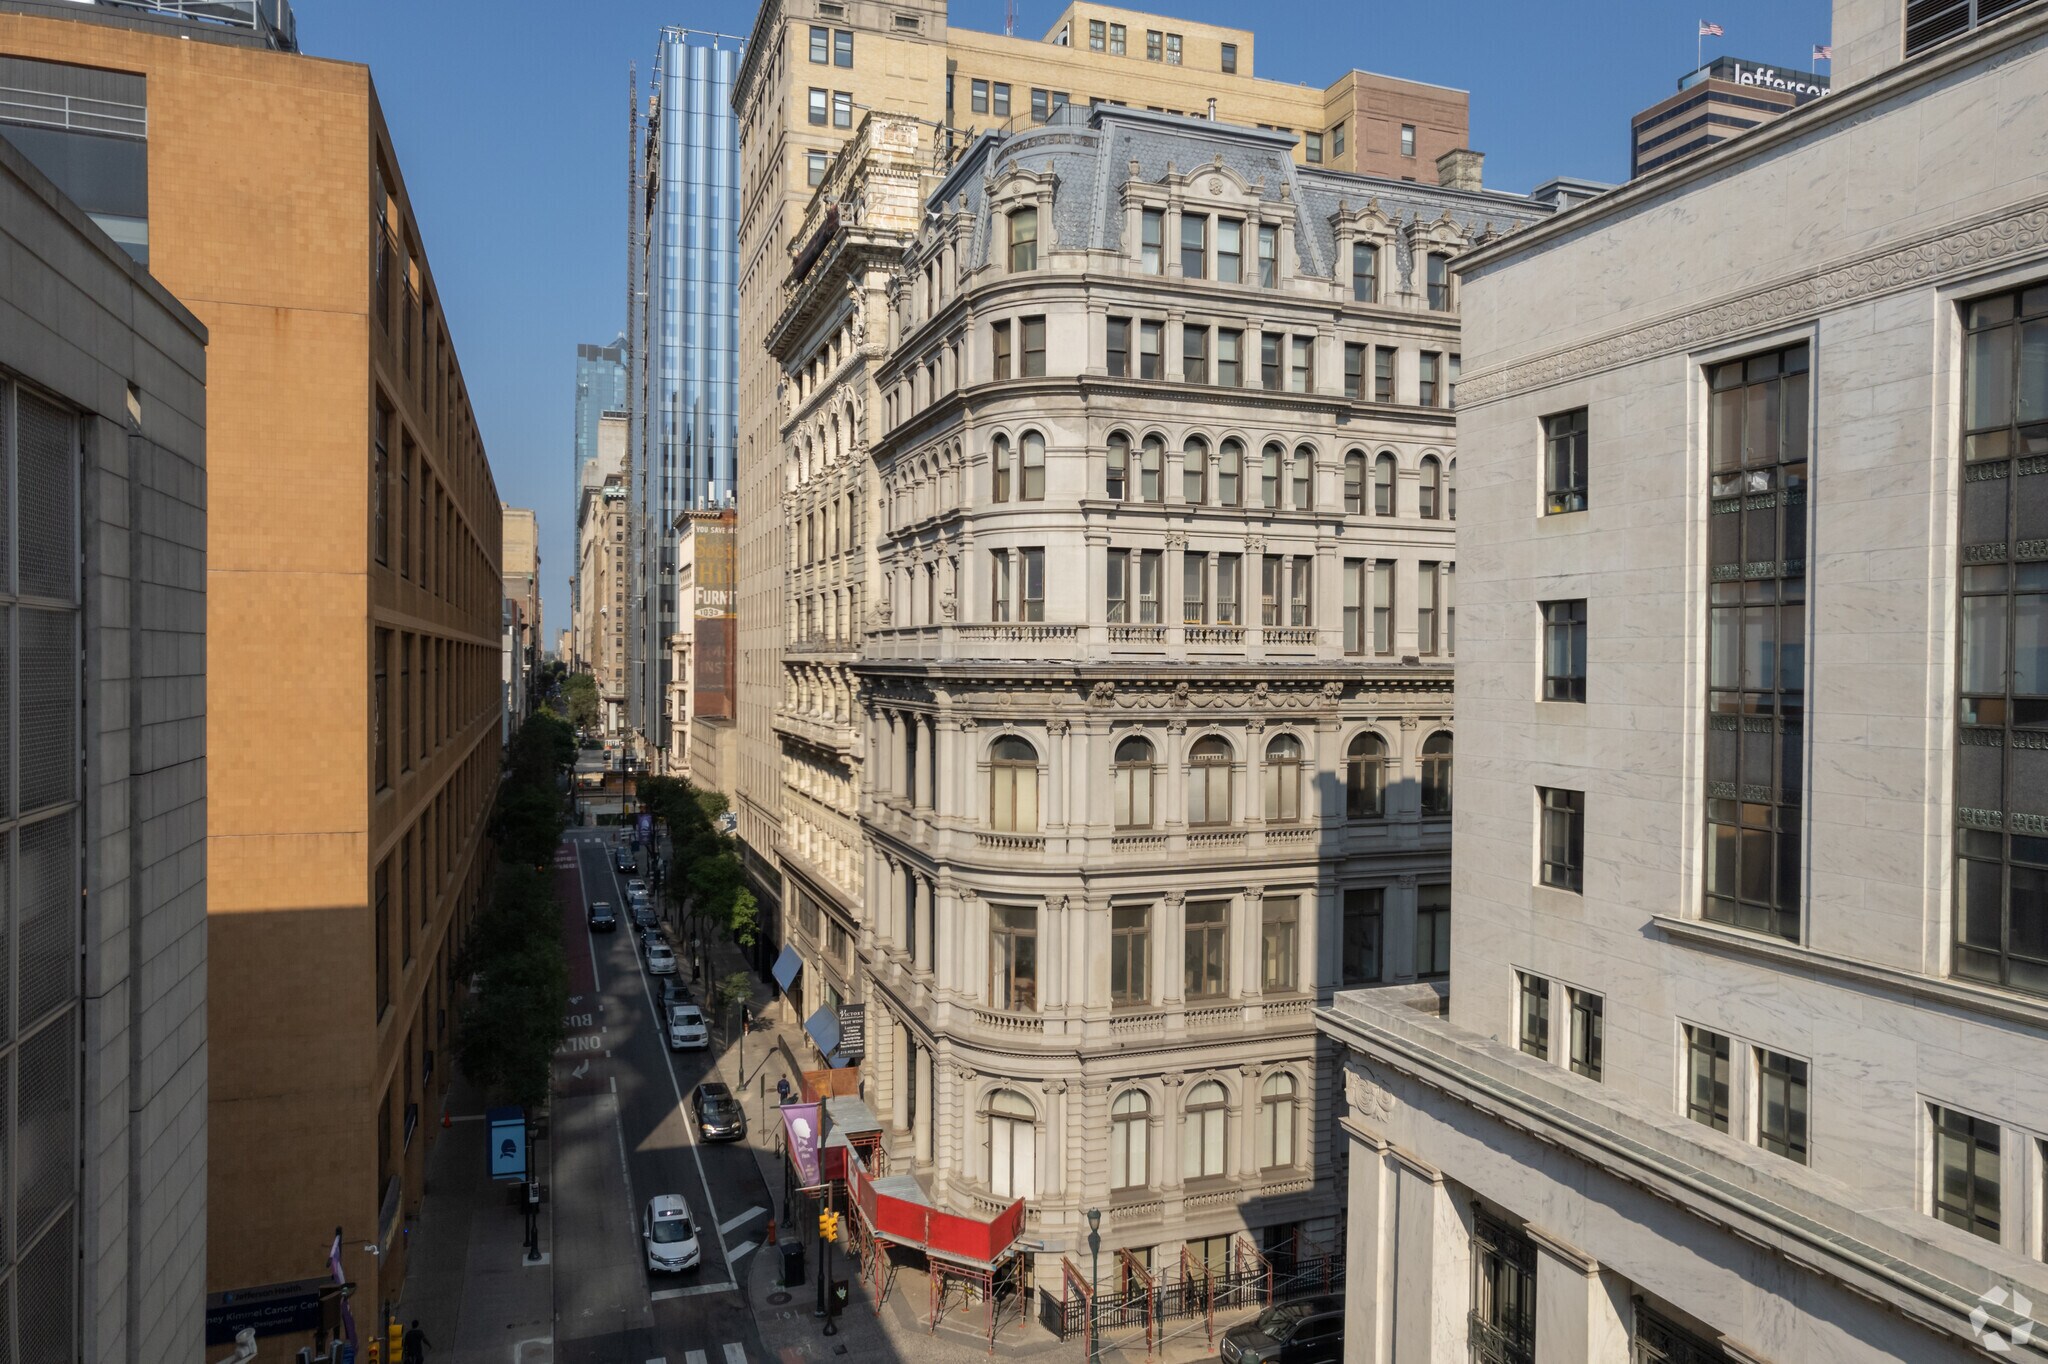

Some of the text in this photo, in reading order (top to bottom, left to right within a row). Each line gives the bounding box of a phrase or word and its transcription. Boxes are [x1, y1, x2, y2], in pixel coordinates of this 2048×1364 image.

[711, 526, 726, 534] SAVE
[235, 1285, 302, 1301] Jefferson Health
[226, 1309, 262, 1321] Kimmel
[264, 1304, 297, 1315] Cancer
